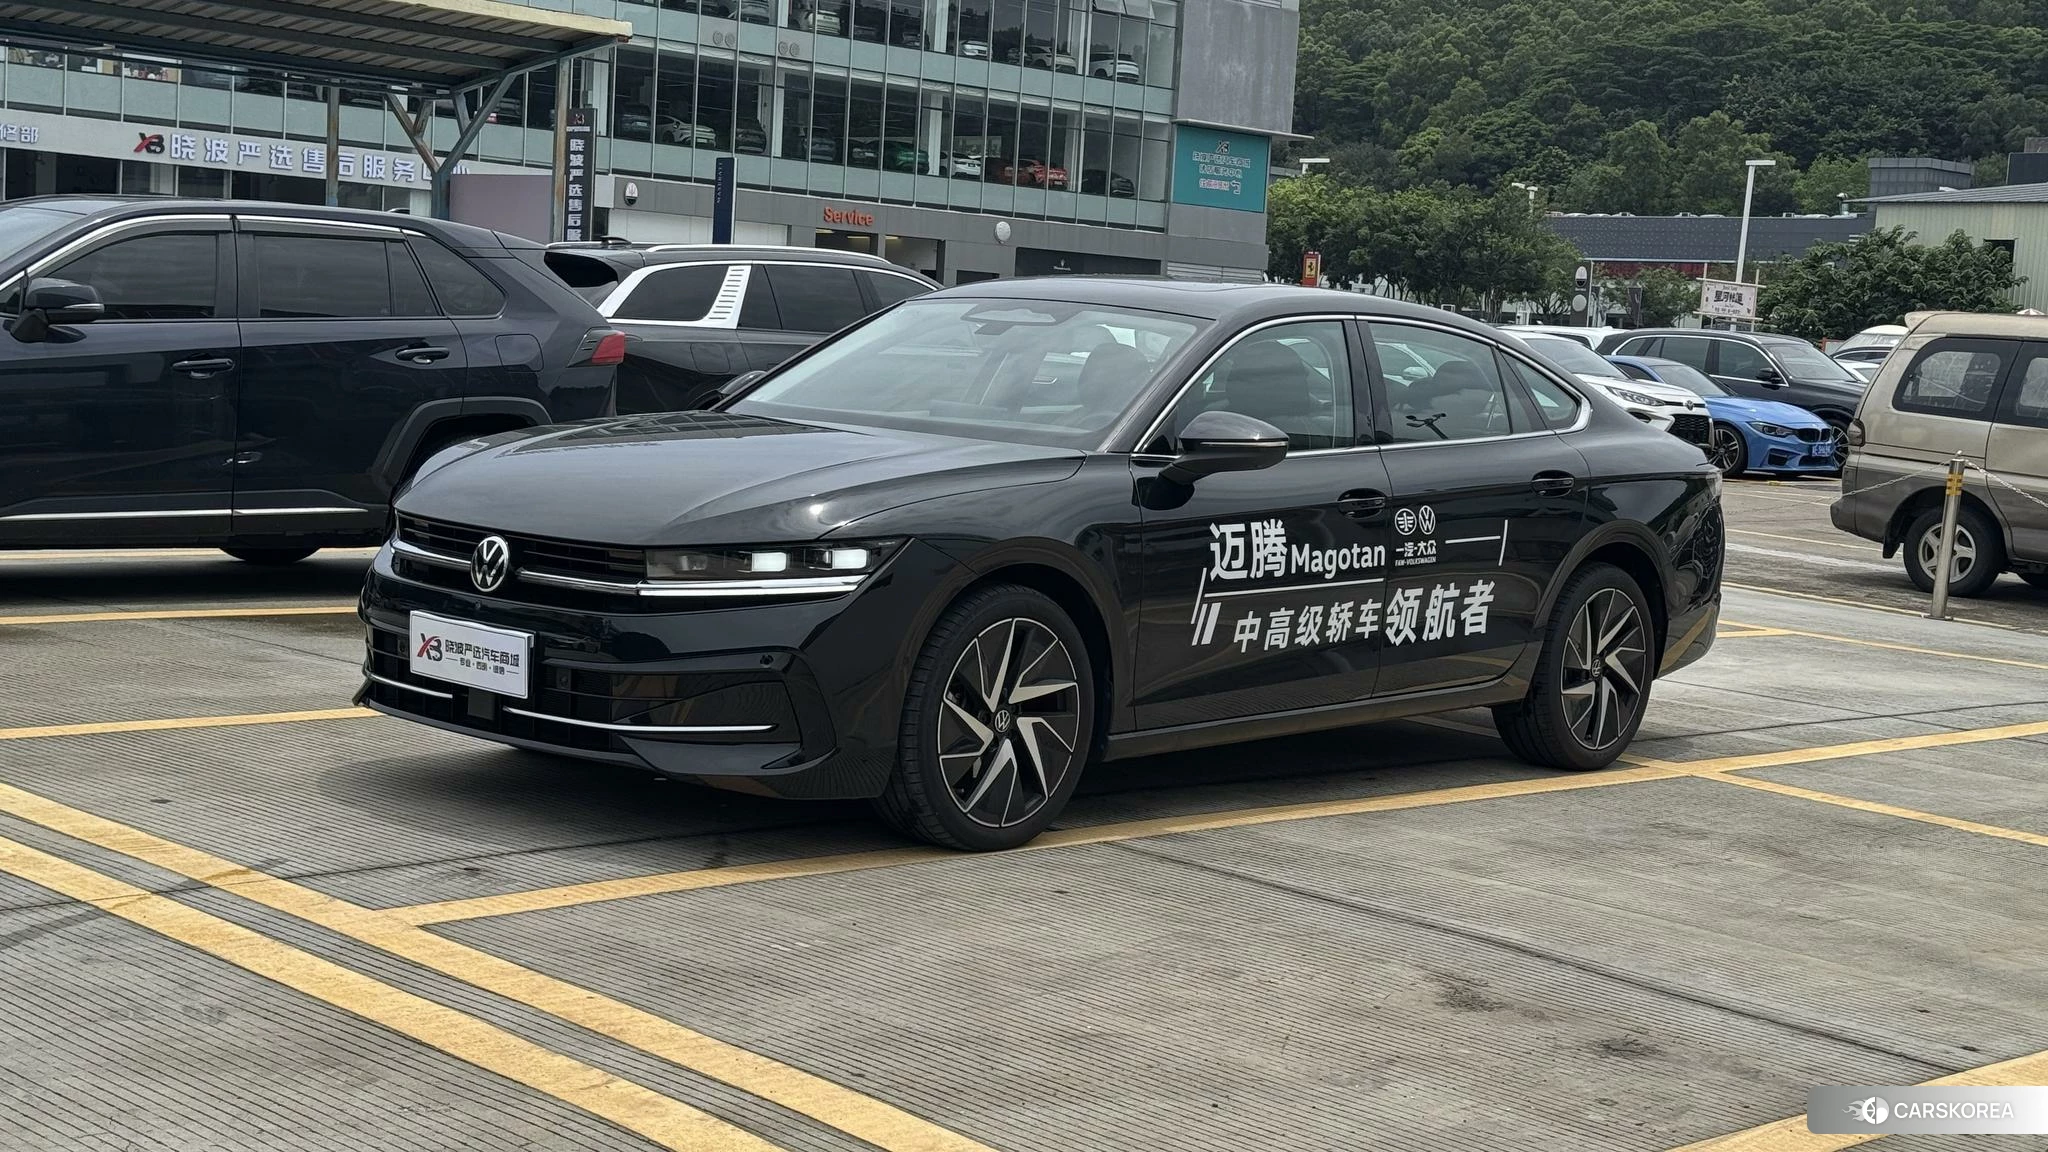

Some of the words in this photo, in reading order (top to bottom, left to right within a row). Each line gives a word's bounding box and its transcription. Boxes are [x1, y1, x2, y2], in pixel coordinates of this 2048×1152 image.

[823, 206, 874, 226] Service
[1209, 518, 1288, 582] 迈腾
[1291, 543, 1387, 579] Magotan
[1233, 579, 1496, 653] 中高级轿车领航者
[444, 639, 520, 668] 晓波严选汽车商城
